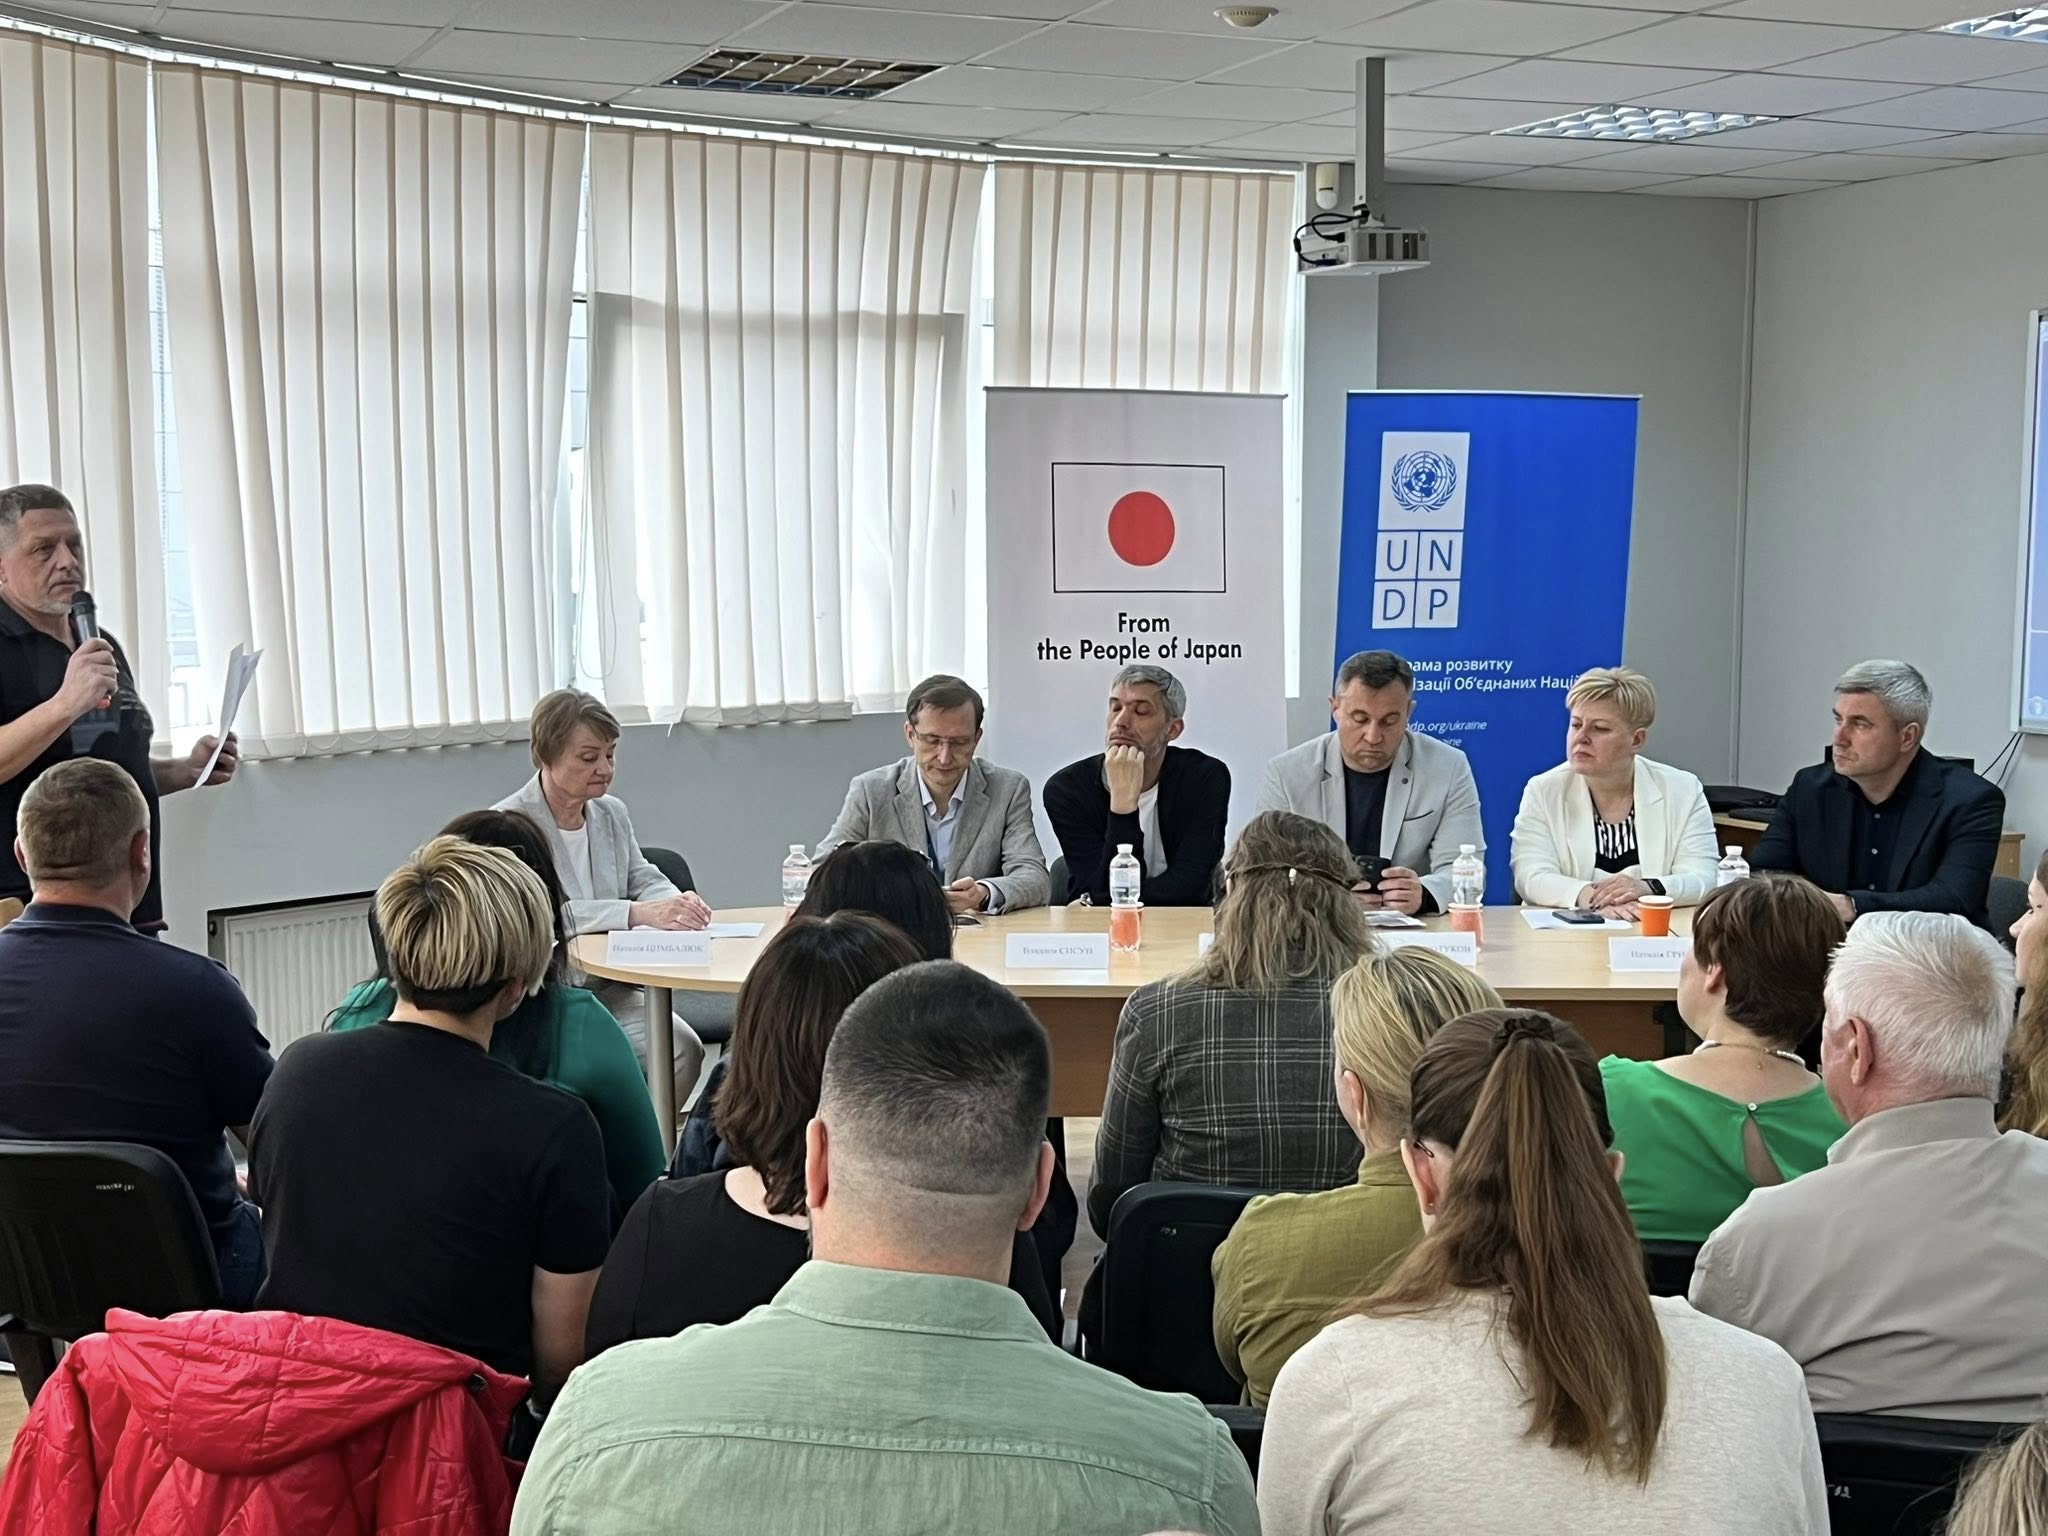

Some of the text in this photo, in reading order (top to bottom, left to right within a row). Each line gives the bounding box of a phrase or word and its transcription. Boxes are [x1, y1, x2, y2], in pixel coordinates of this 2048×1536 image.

[1118, 612, 1170, 633] From
[1037, 636, 1242, 666] the People of Japan
[1446, 659, 1513, 675] розвитку
[1412, 677, 1452, 693] ізації
